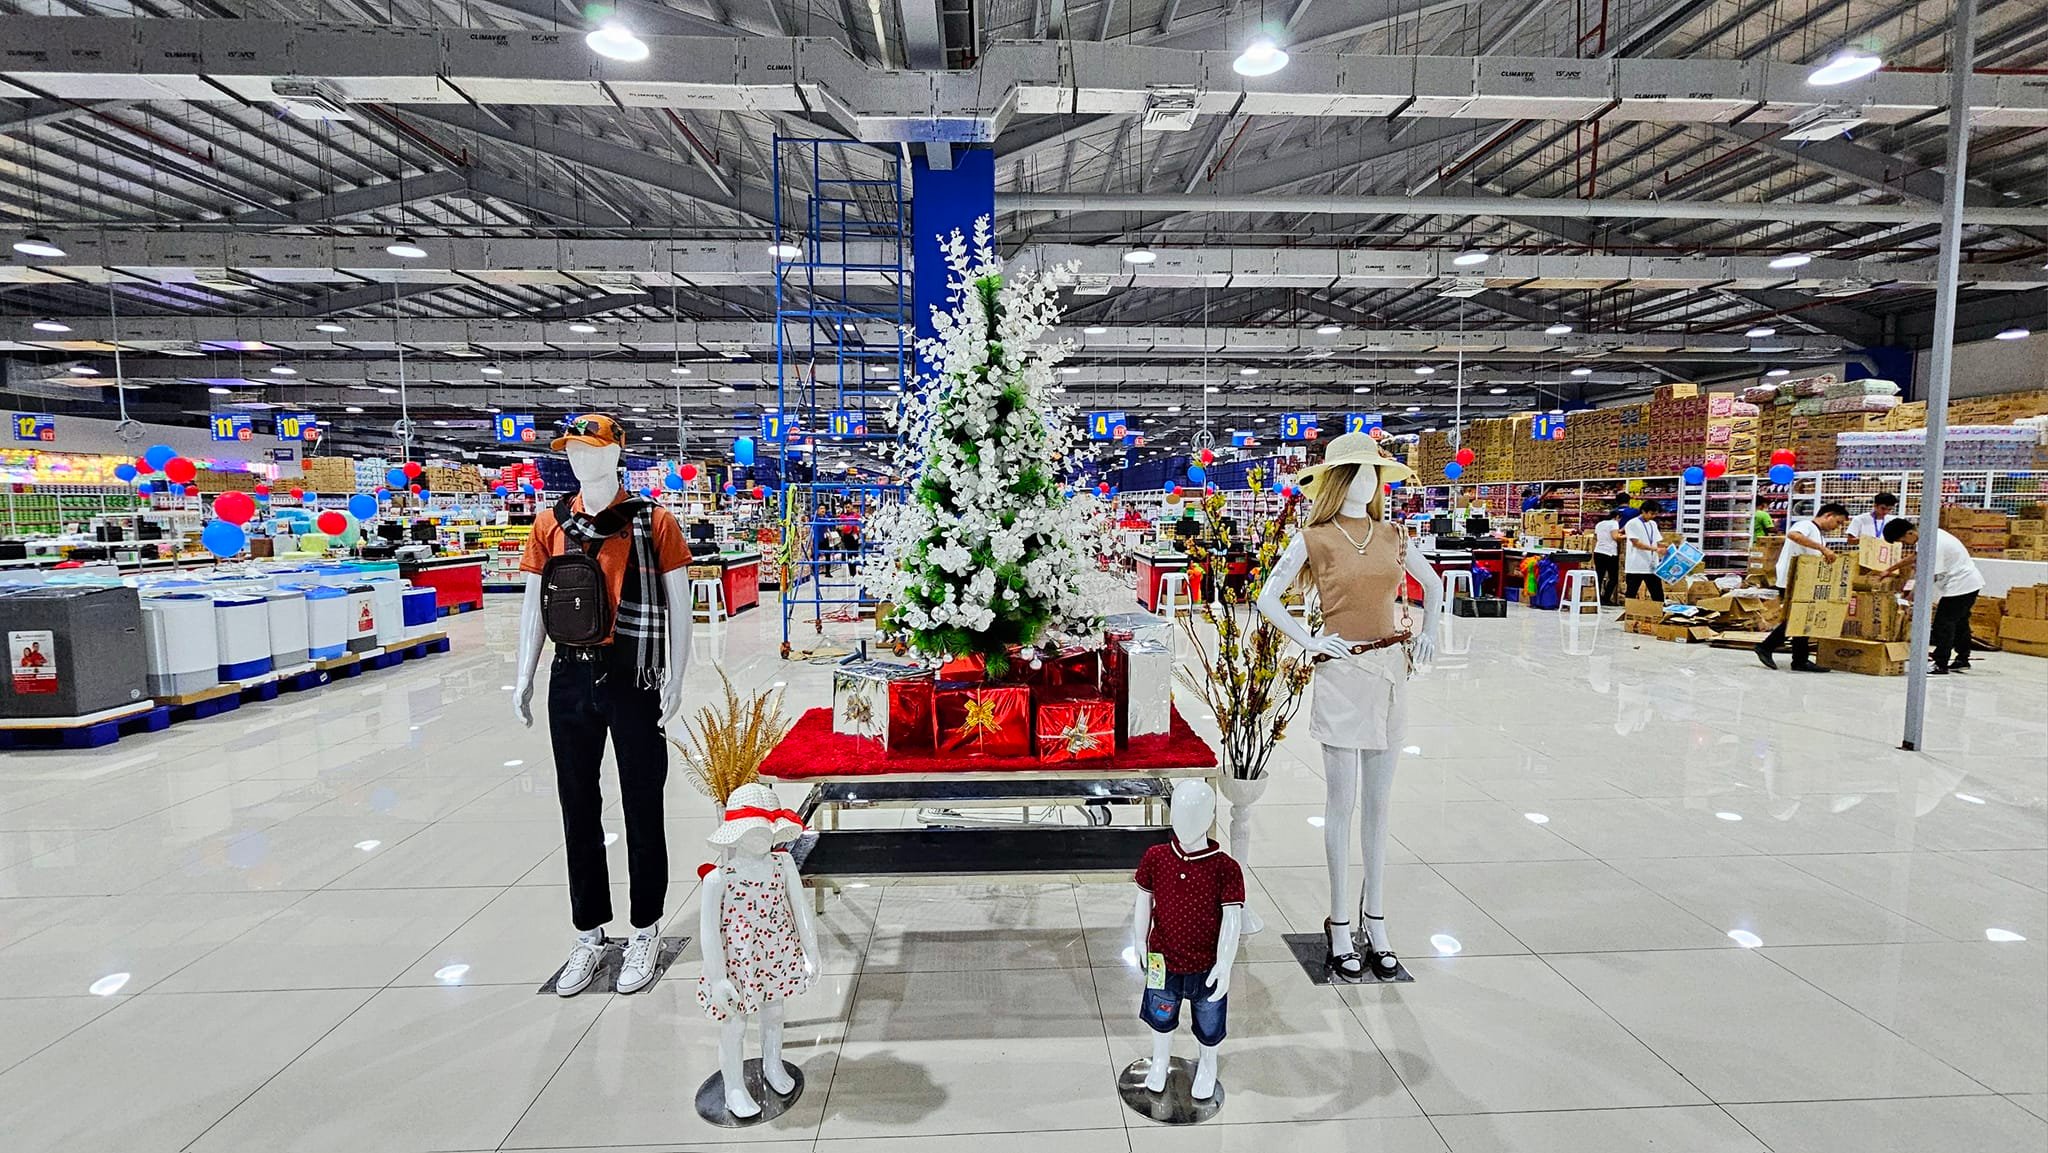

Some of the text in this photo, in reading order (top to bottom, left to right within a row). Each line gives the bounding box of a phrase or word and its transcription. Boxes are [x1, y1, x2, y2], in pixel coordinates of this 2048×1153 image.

[18, 417, 37, 437] 12
[216, 418, 233, 437] 11
[281, 418, 299, 437] 10
[502, 417, 515, 437] 9
[768, 418, 779, 437] 7
[1095, 416, 1107, 435] 4
[1286, 417, 1298, 436] 3
[1352, 417, 1364, 433] 2
[1539, 417, 1547, 436] 1
